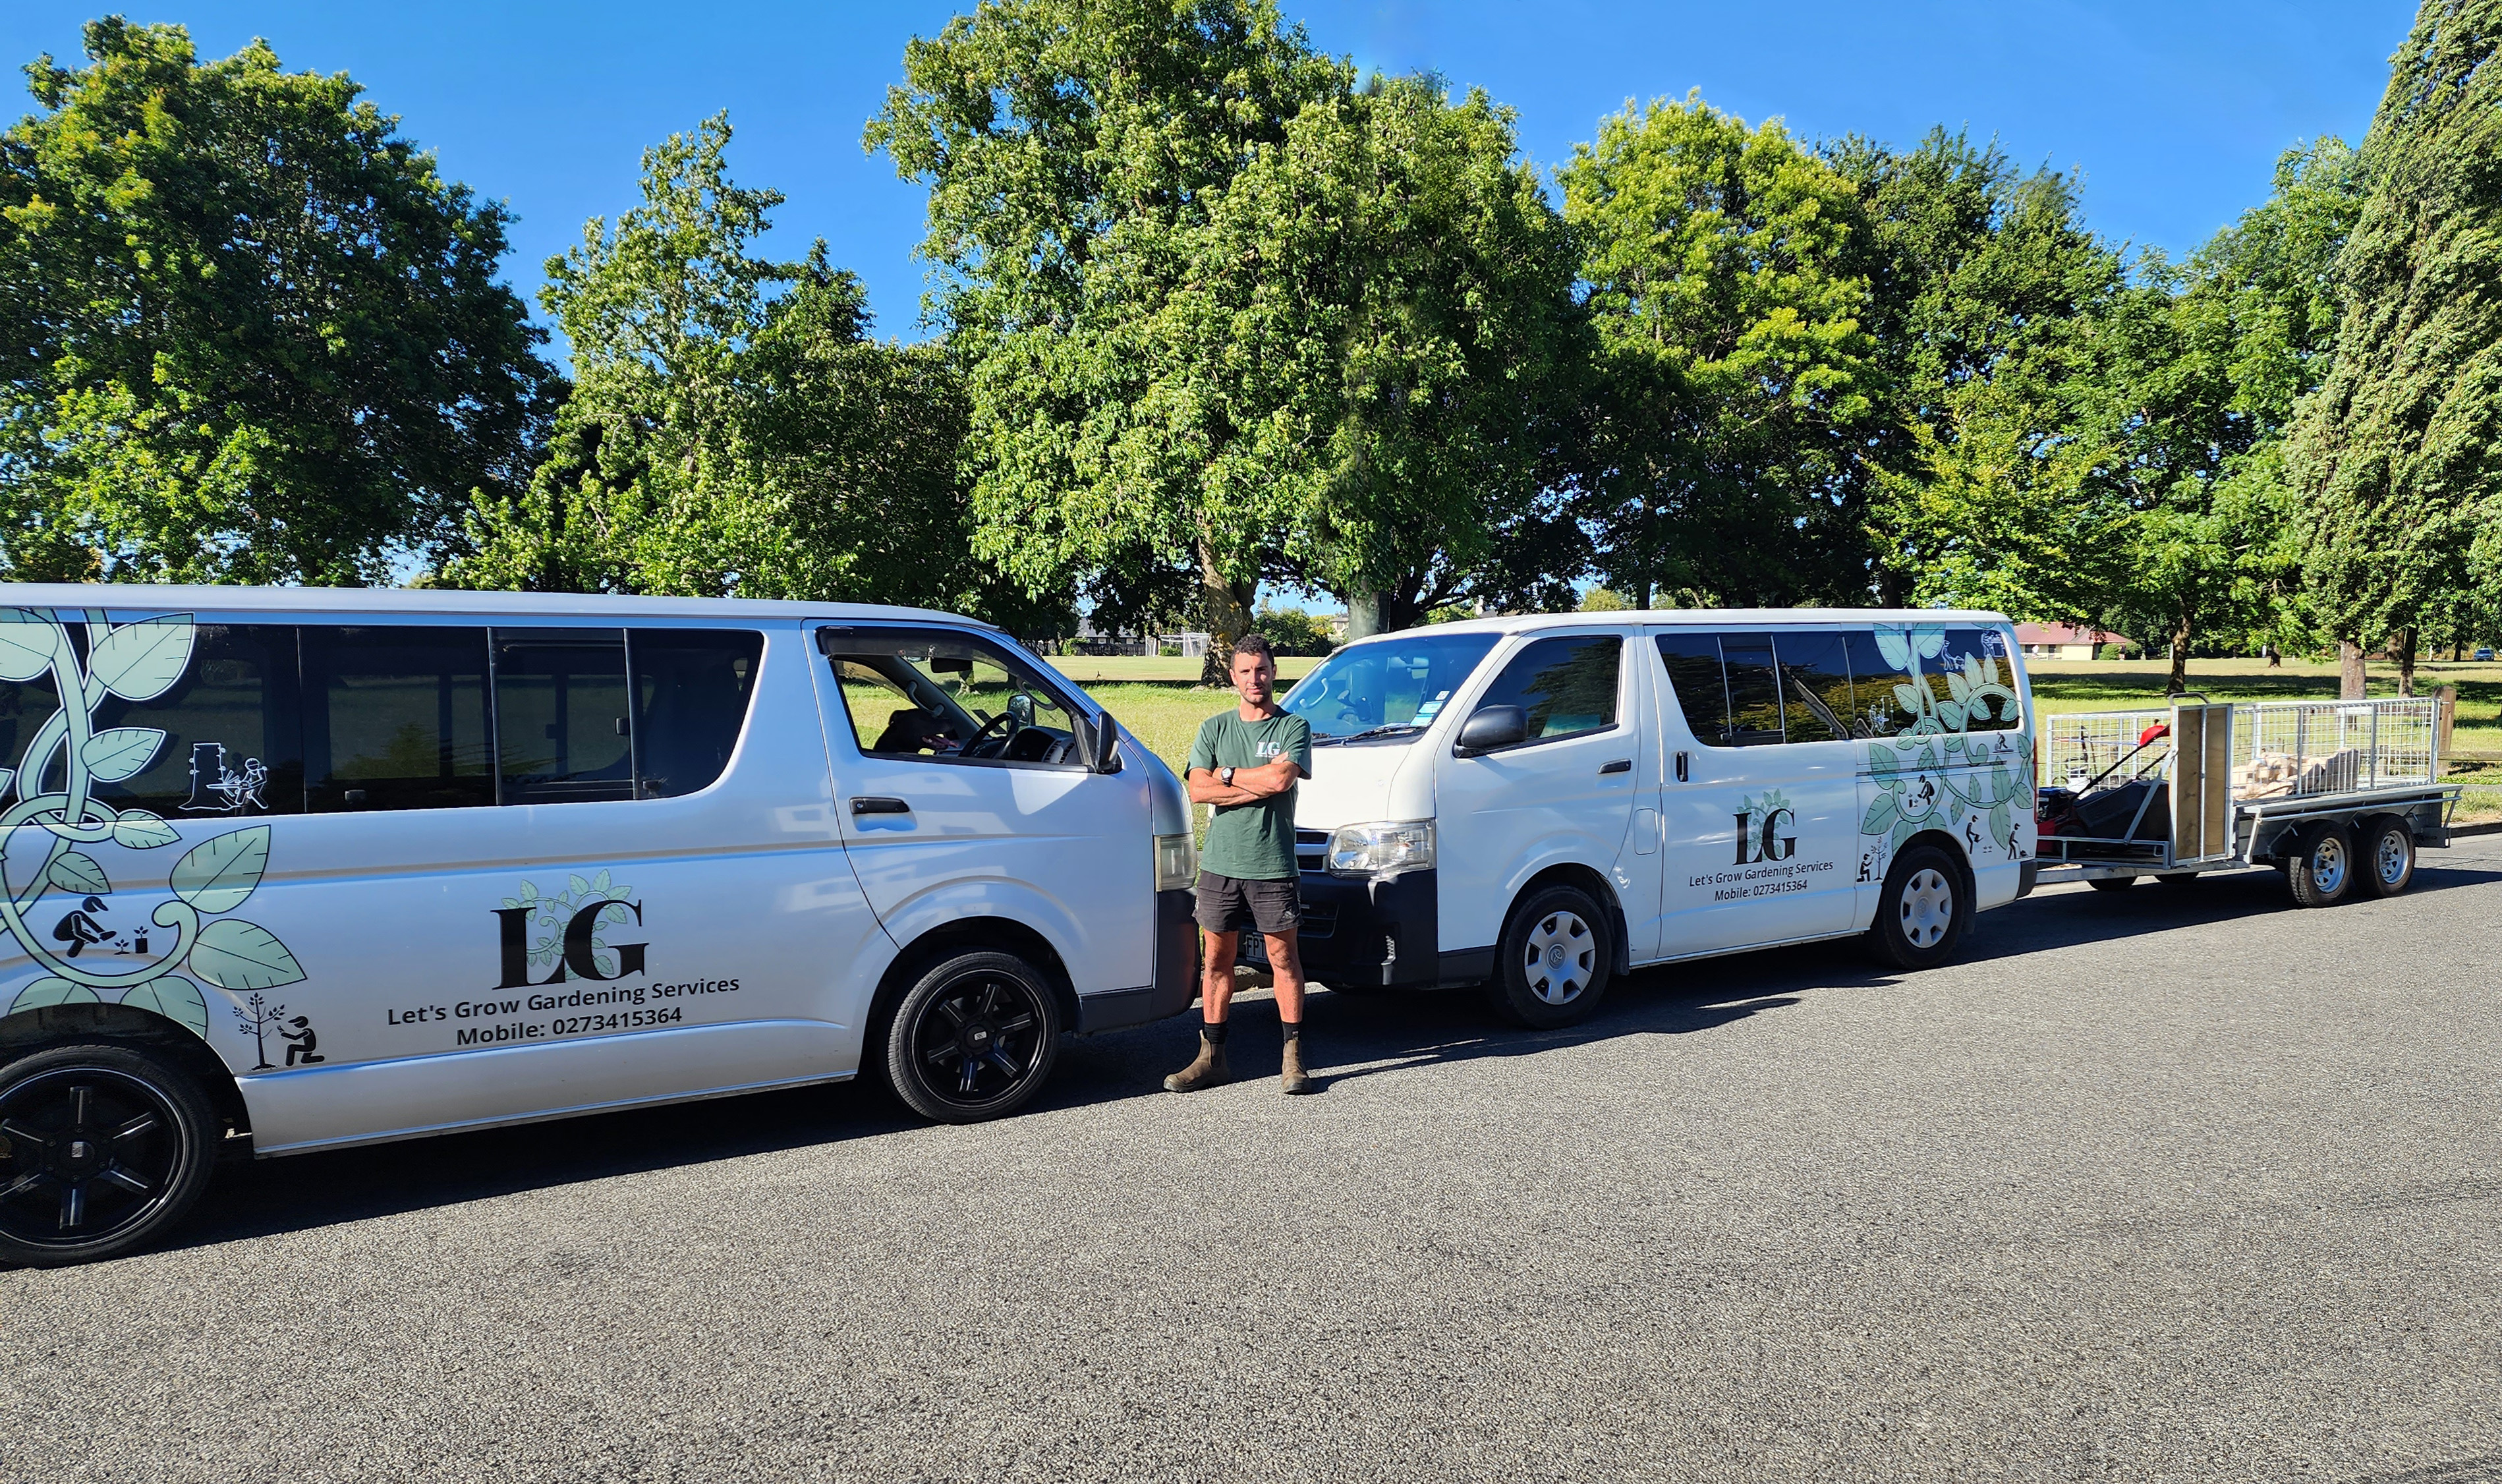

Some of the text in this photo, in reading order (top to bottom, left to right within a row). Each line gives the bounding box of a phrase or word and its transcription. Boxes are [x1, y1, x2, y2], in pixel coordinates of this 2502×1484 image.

[1256, 741, 1280, 755] LG
[1732, 808, 1798, 866] LG
[1689, 861, 1834, 887] Let's Grow Gardening Services
[1714, 879, 1808, 901] Mobile: 0273415364
[490, 899, 650, 990] LG
[387, 977, 741, 1026] Let's Grow Gardening Services
[456, 1006, 683, 1046] Mobile: 0273415364
